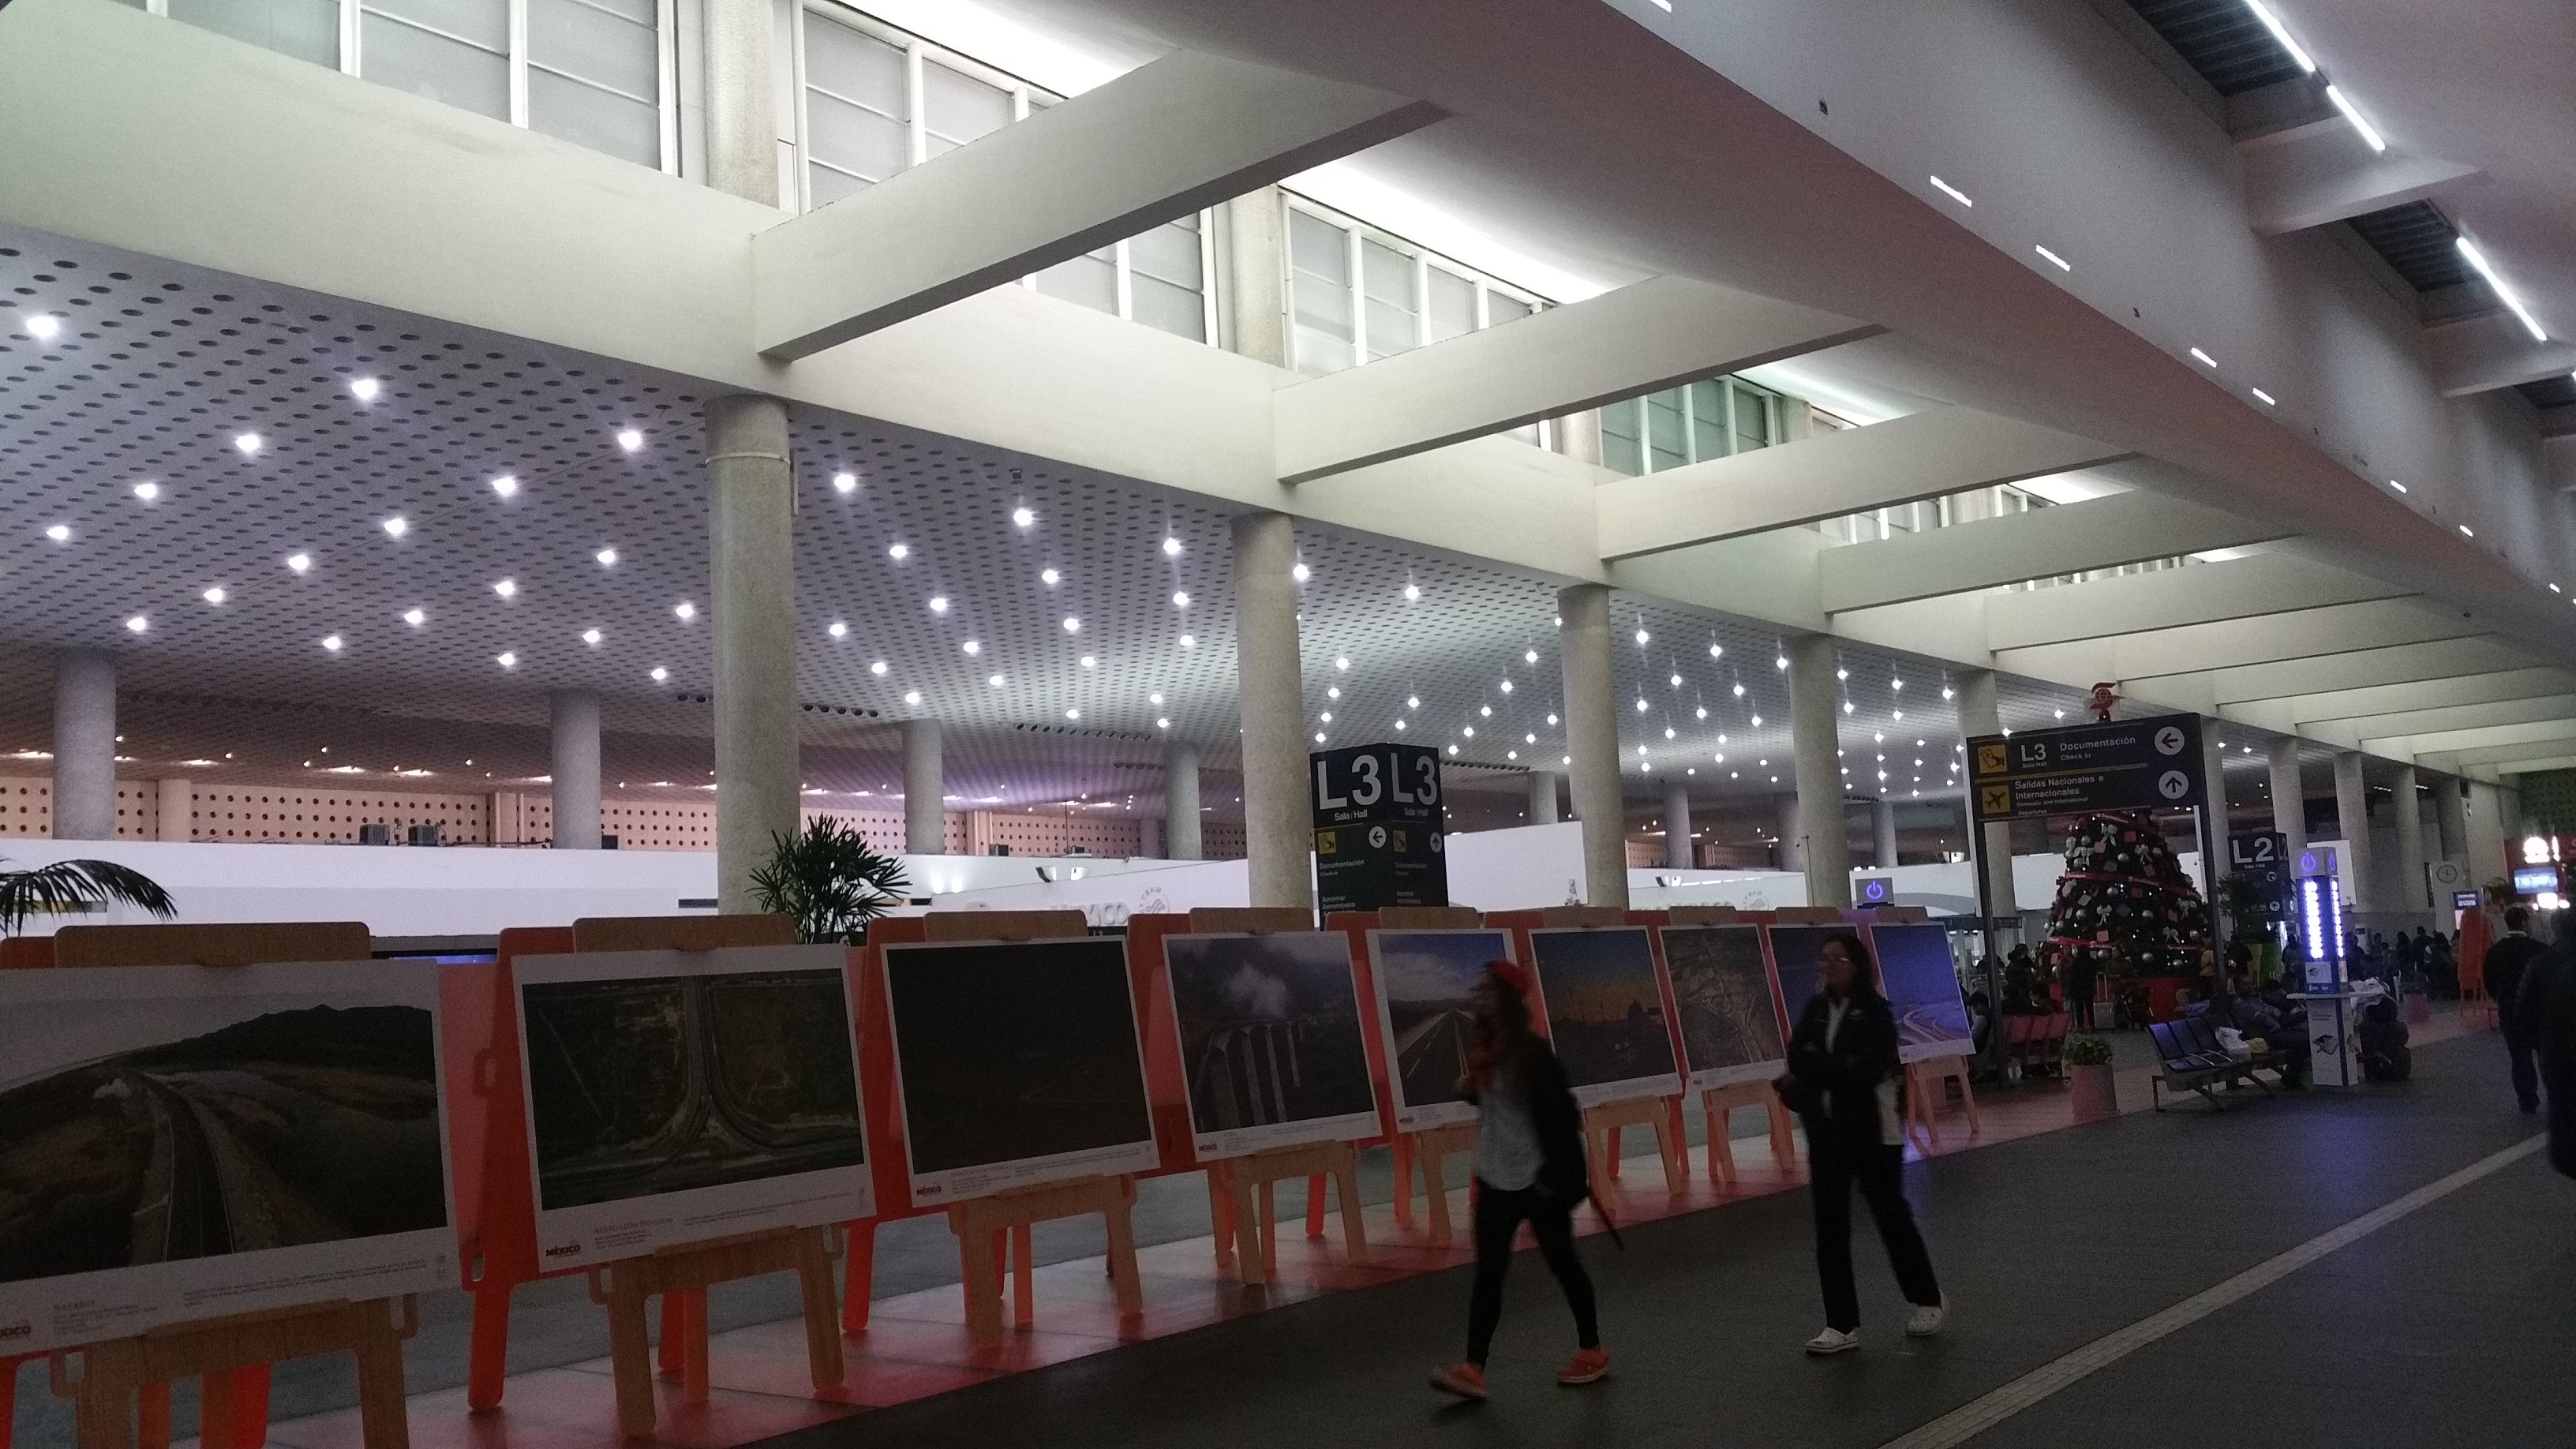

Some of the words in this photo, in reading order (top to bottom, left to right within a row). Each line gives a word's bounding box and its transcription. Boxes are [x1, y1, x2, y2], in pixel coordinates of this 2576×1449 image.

[2060, 736, 2136, 751] Documentación
[2020, 743, 2047, 762] L3
[1316, 754, 1382, 811] L3
[1390, 752, 1438, 806] L3
[2014, 780, 2046, 789] Salidas
[2048, 776, 2095, 787] Nacionales
[2016, 788, 2080, 800] Internacionales
[1334, 811, 1350, 821] Sala
[1354, 809, 1368, 818] Hall
[2232, 837, 2275, 863] L2
[1319, 859, 1365, 870] Documentación
